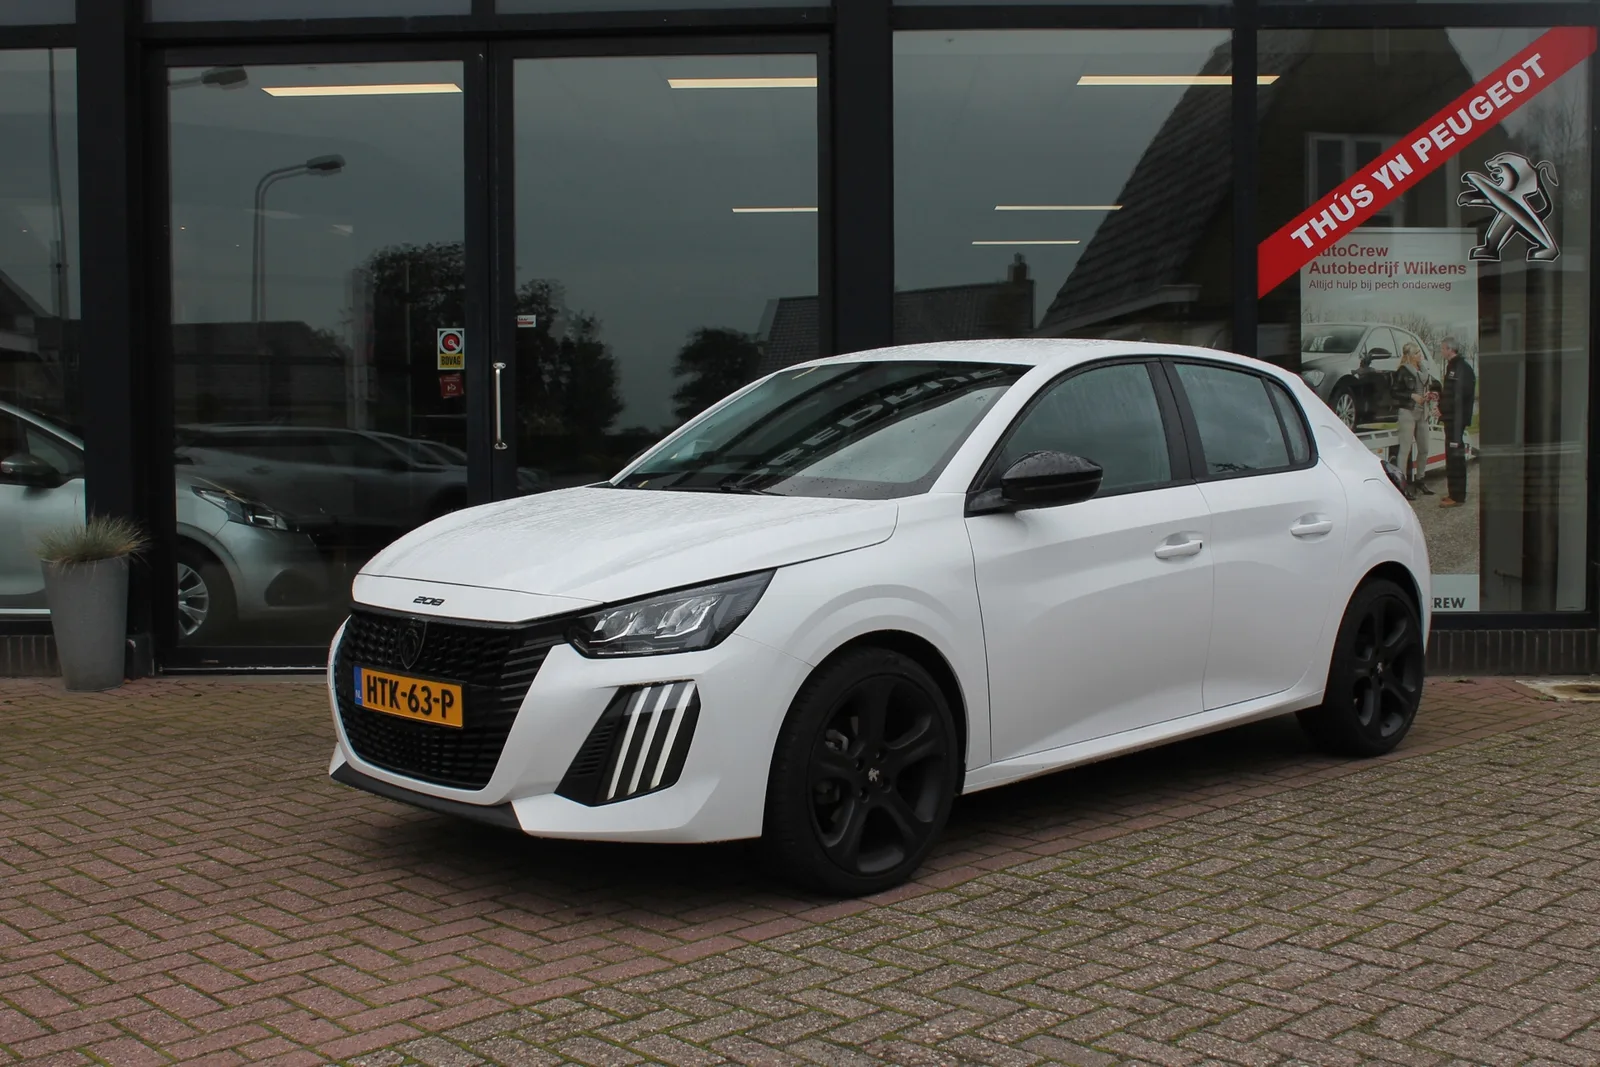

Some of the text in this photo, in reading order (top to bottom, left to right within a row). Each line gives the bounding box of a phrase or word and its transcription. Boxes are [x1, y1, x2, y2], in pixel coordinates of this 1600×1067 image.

[1290, 53, 1546, 249] THÚS YN PEUGEOT
[1318, 243, 1389, 257] utoCrew
[1308, 261, 1467, 278] Autobedrijf Wilkens
[1308, 280, 1452, 291] Altijd hulp bij pech onderweg
[441, 355, 461, 366] BOVAG
[413, 595, 445, 607] 208
[1431, 597, 1466, 609] REW
[366, 675, 455, 719] HTK-63-P
